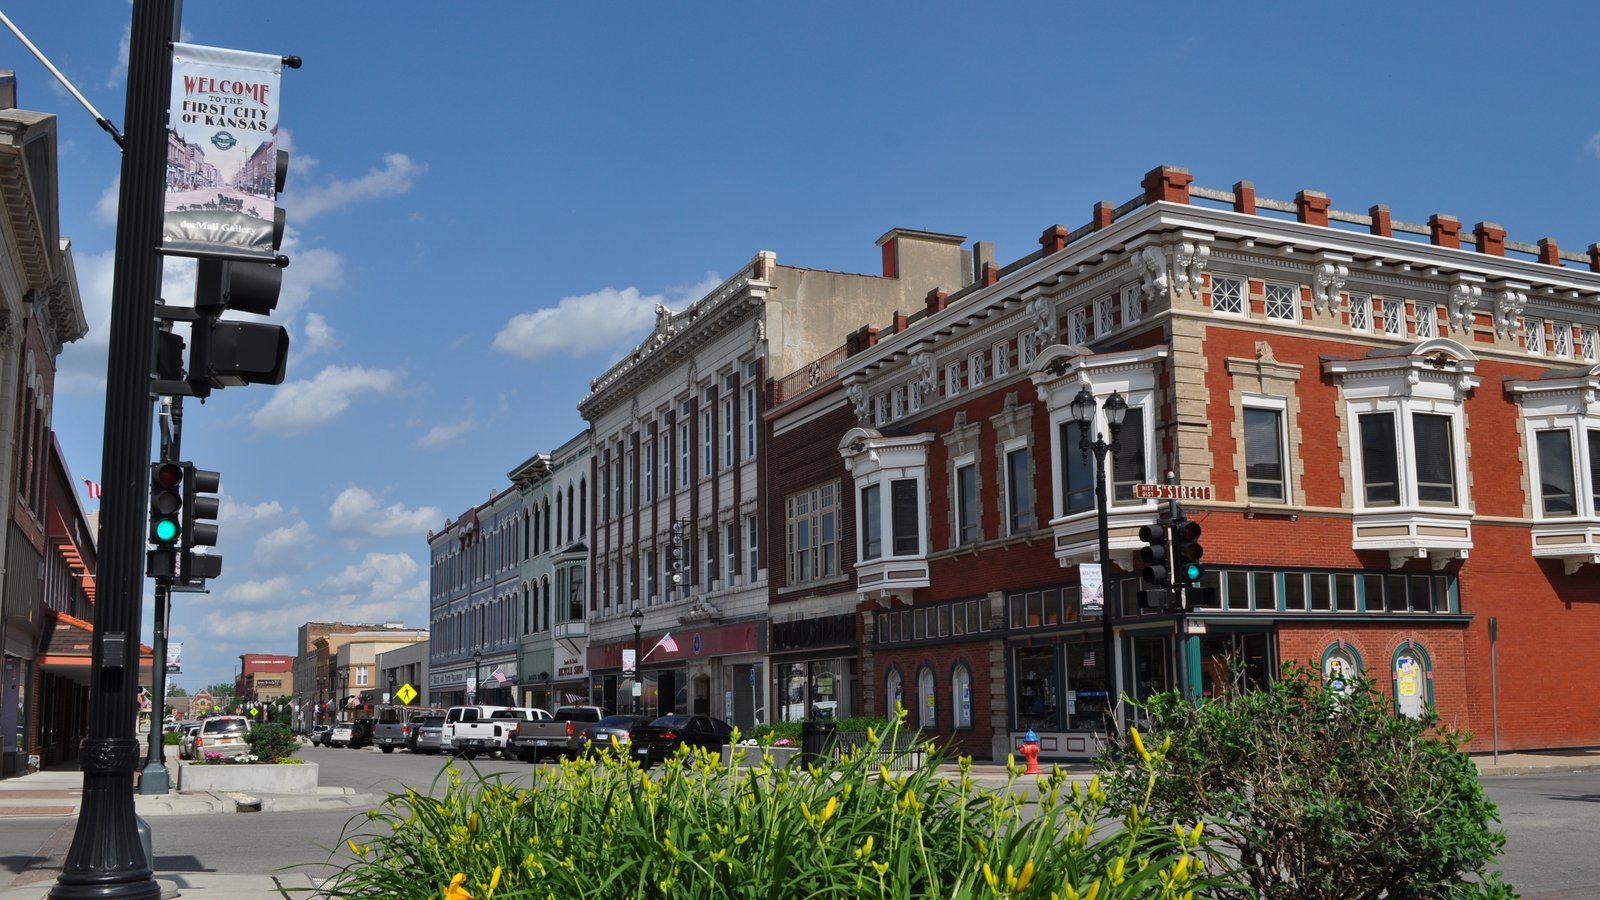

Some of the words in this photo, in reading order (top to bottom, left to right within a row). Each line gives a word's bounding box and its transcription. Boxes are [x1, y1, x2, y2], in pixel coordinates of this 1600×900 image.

[184, 75, 270, 107] WELCOME
[222, 97, 243, 105] THE
[182, 100, 228, 115] FIRST
[234, 107, 269, 120] CITY
[182, 114, 199, 124] OF
[205, 115, 268, 131] KANSAS
[221, 223, 257, 236] Gallery
[1168, 485, 1207, 499] STREET
